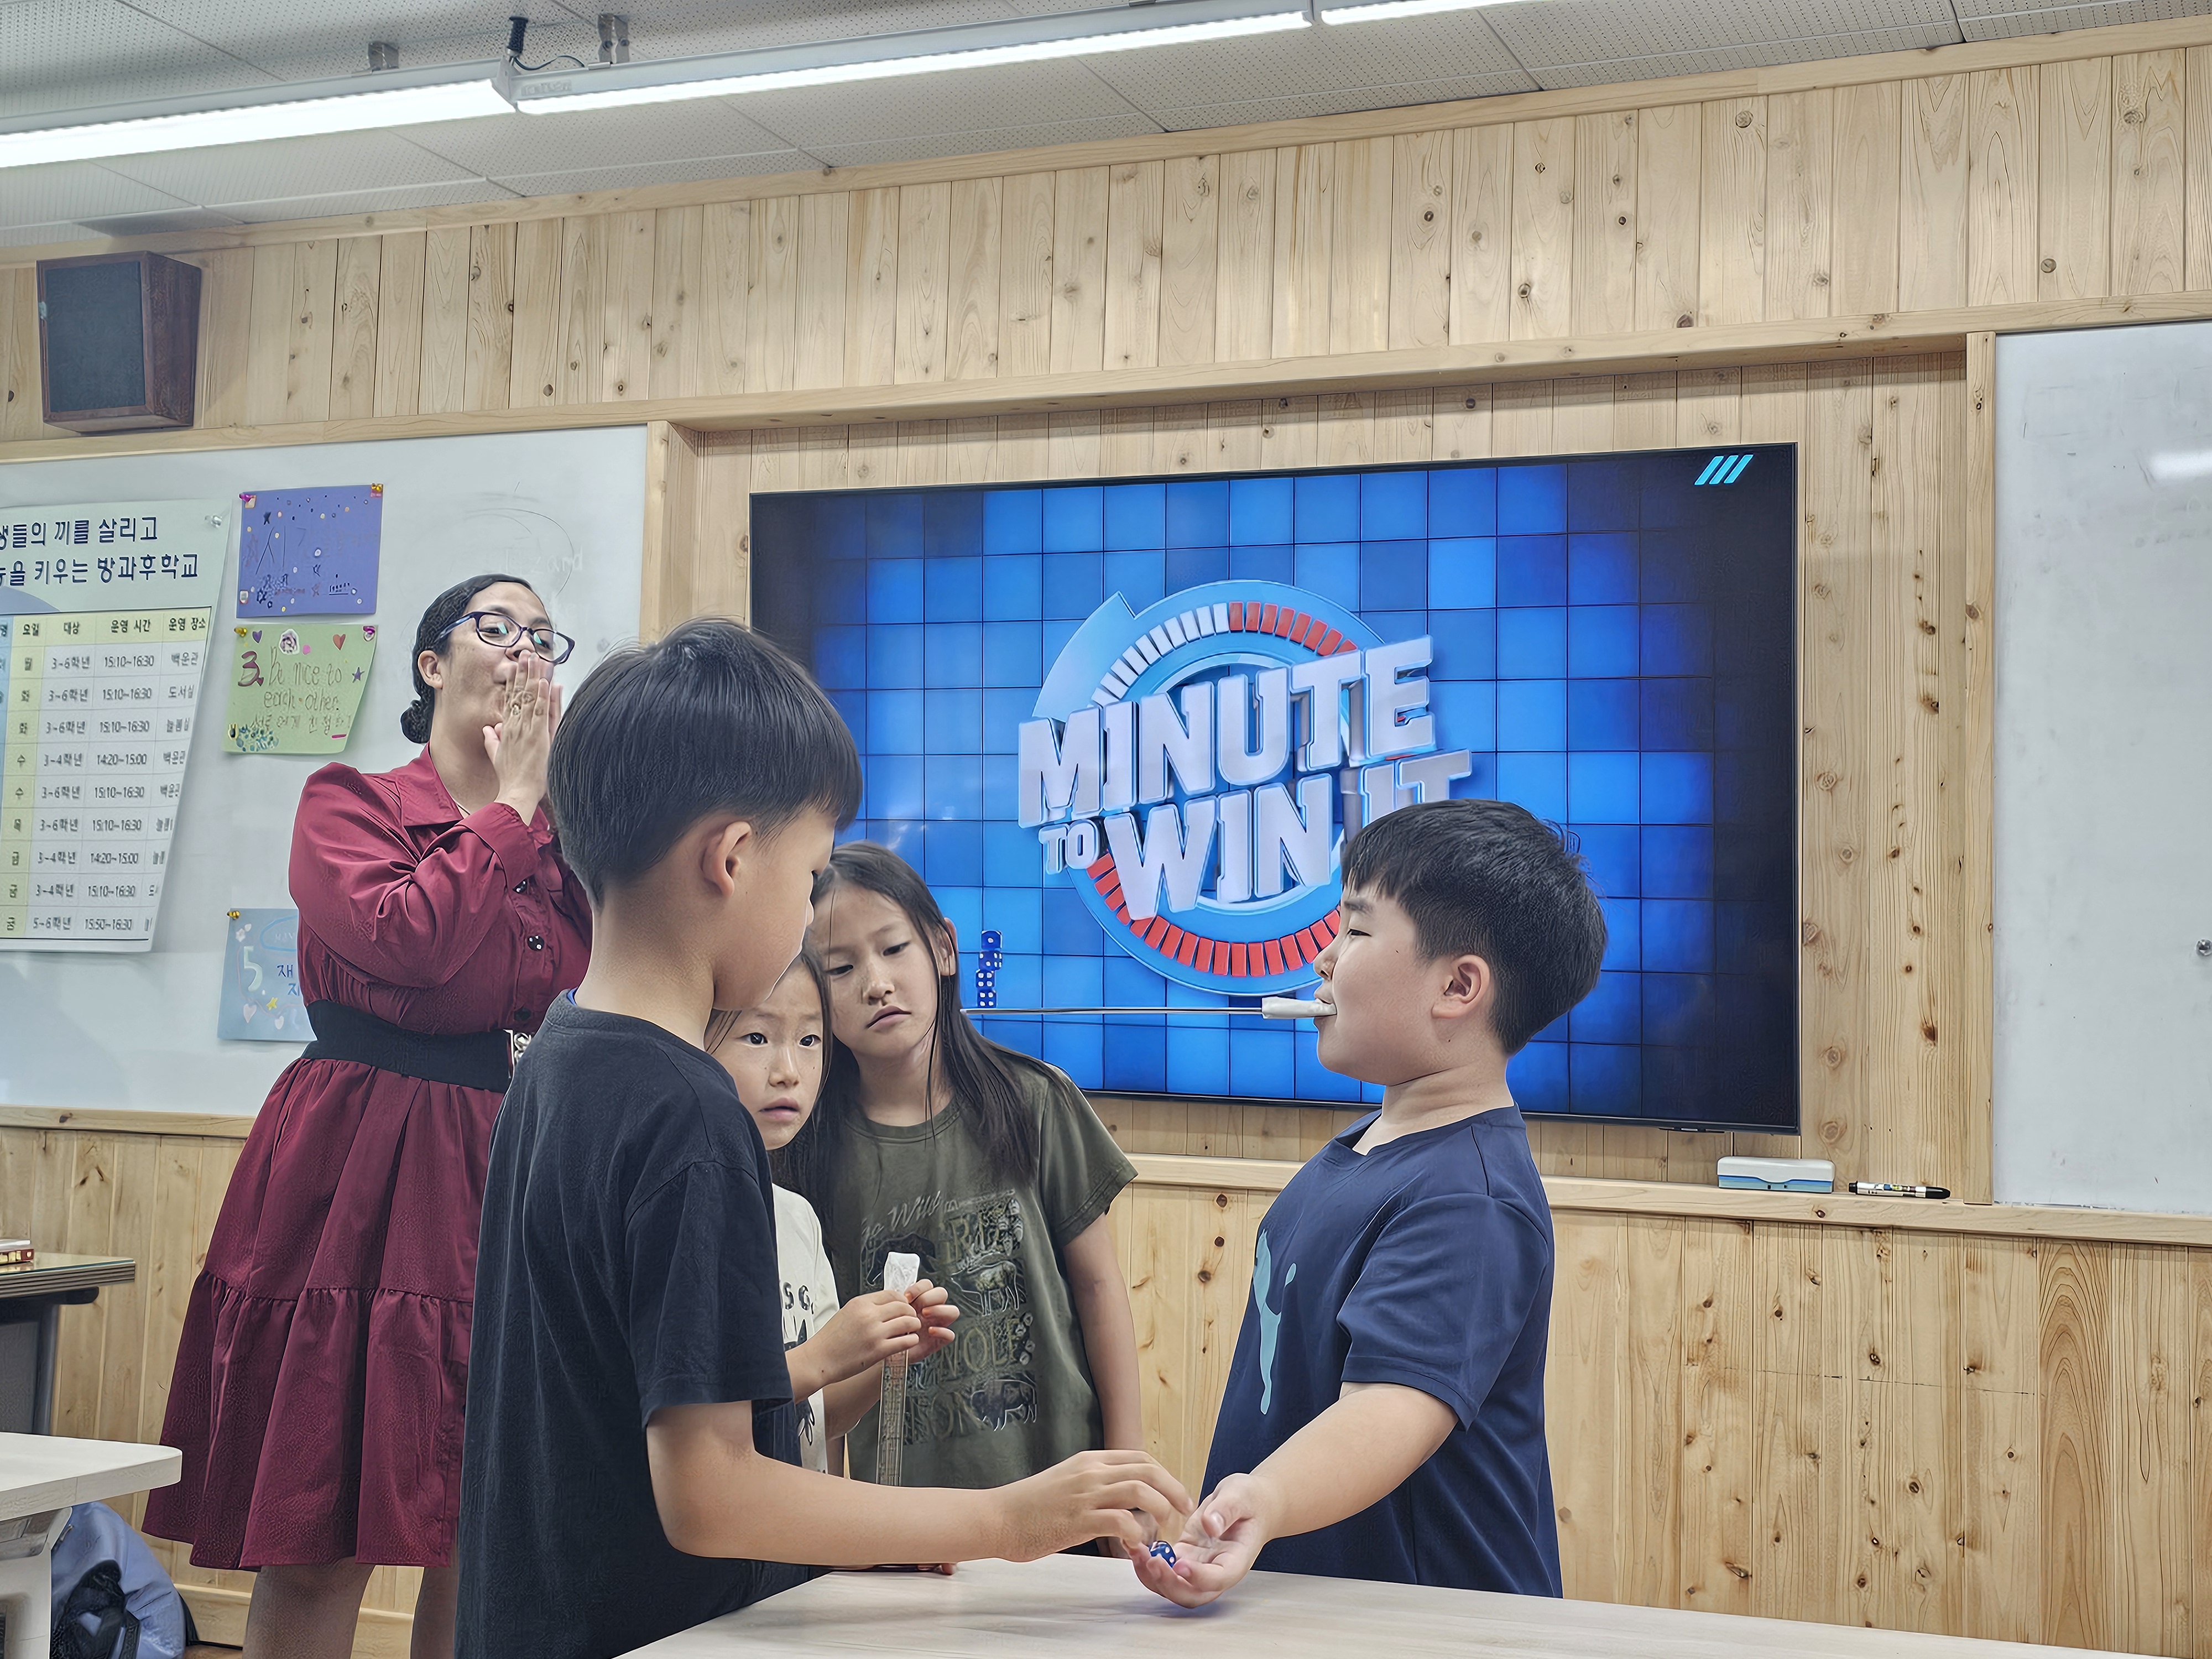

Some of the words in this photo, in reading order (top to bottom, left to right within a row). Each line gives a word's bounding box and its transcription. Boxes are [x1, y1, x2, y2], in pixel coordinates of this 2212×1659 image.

[54, 520, 89, 546] 끼를
[98, 516, 158, 544] 살리고
[34, 558, 88, 585] 키우는
[97, 553, 199, 584] 방과후학교
[23, 623, 39, 637] 요일
[63, 622, 80, 635] 대상
[110, 620, 128, 633] 운영
[133, 618, 151, 633] 시간
[169, 618, 185, 631] 운영
[191, 617, 207, 630] 장소
[1018, 634, 1436, 828] MINUTE
[1038, 818, 1102, 875] TO
[1104, 773, 1334, 920] WIN
